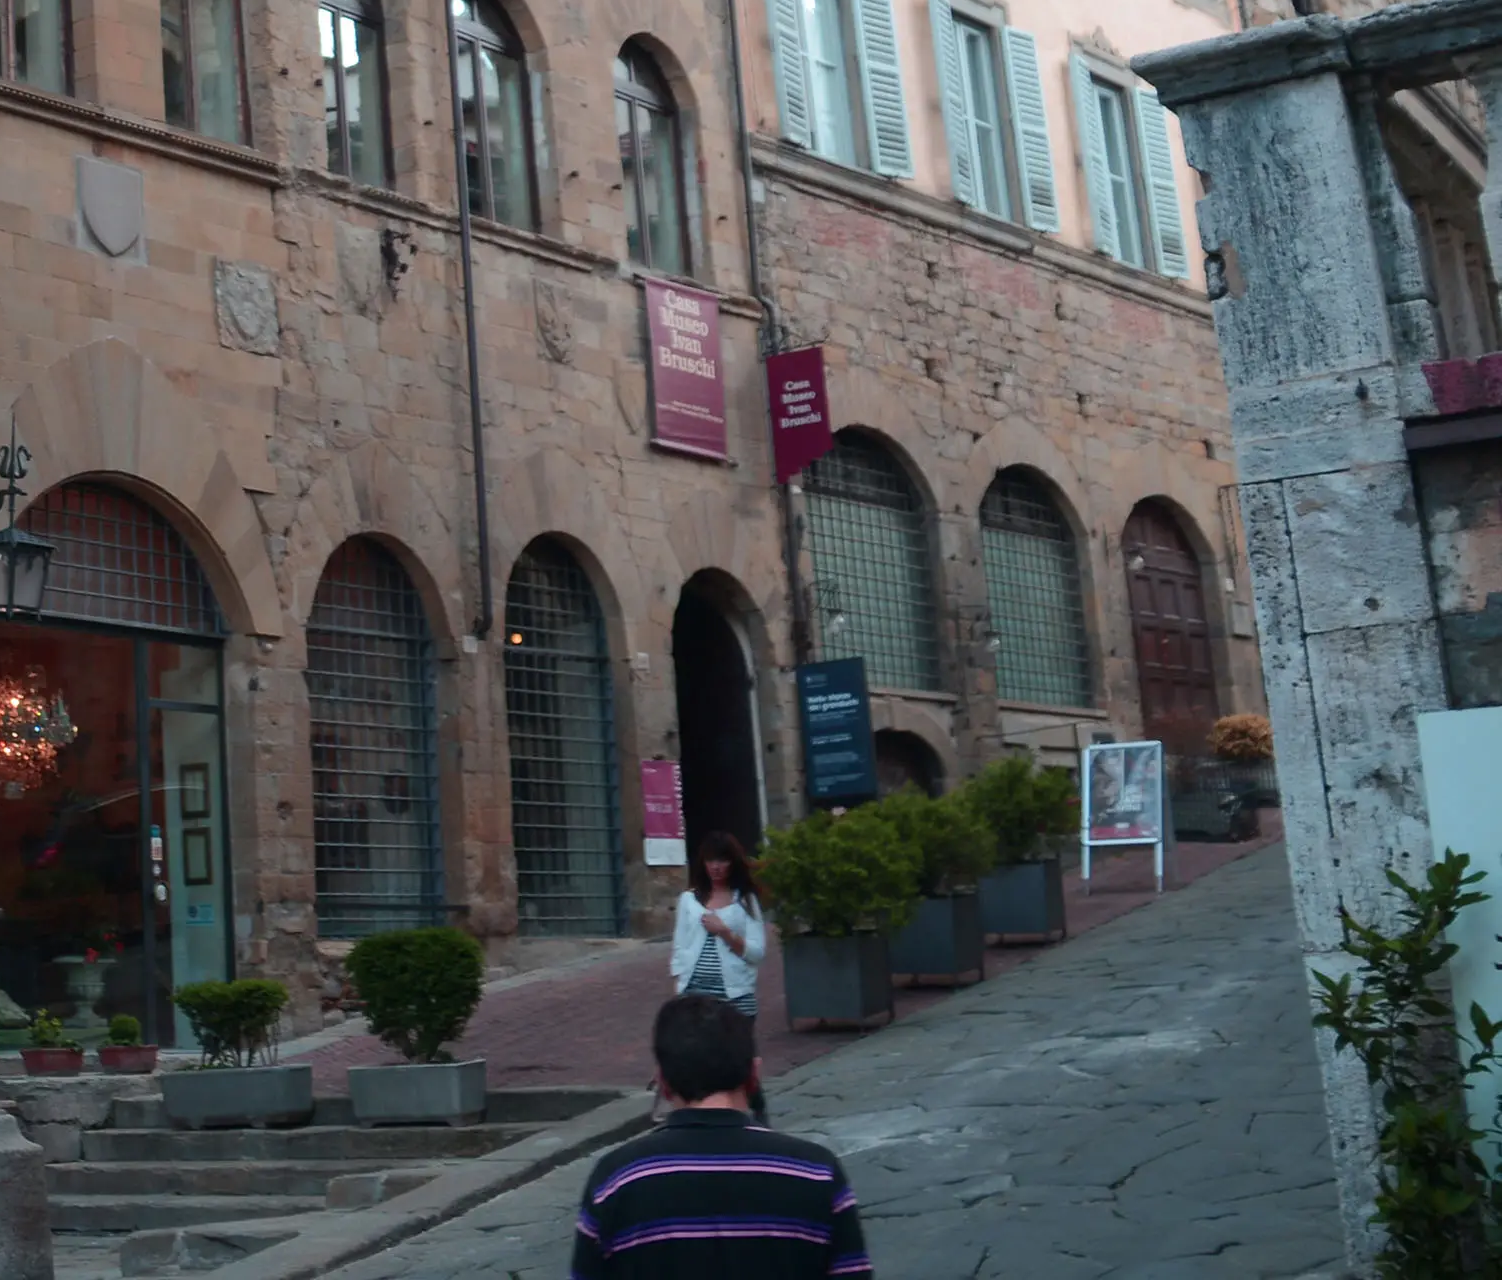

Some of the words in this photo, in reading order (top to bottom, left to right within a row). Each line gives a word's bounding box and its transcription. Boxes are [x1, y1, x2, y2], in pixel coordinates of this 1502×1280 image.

[664, 289, 701, 317] Casa
[658, 306, 709, 337] Museo
[670, 329, 703, 355] Ivan
[659, 346, 716, 380] Bruschi
[785, 380, 811, 391] Casa
[781, 391, 816, 404] Museo
[789, 404, 812, 415] Ivan
[781, 412, 822, 429] Bruschi
